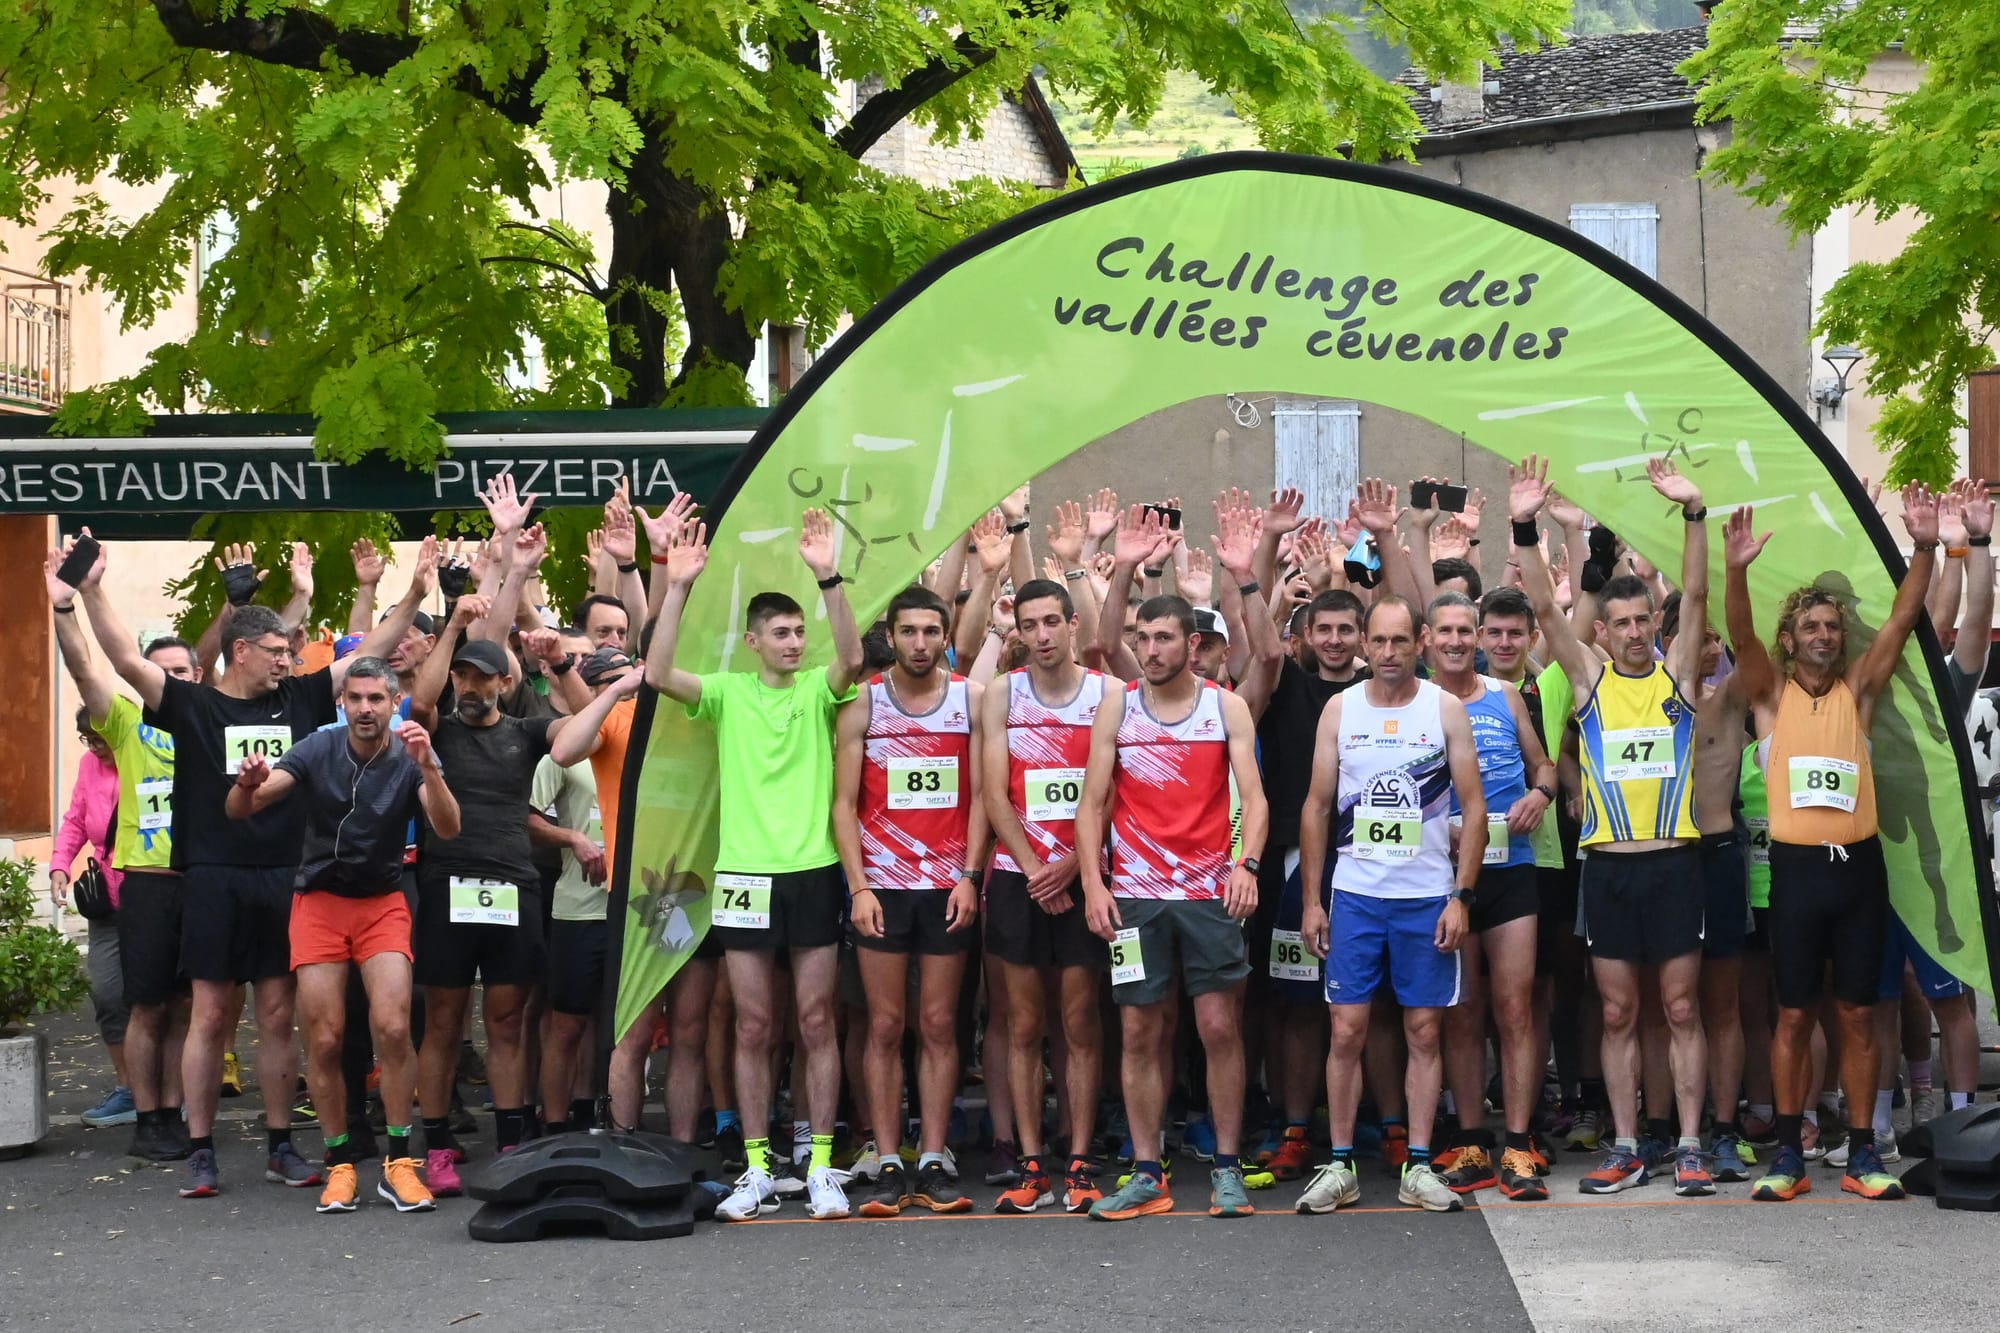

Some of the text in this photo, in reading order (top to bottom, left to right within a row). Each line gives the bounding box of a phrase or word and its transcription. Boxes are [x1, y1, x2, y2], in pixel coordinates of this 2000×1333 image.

[1097, 236, 1540, 321] Challenge des
[1054, 296, 1570, 362] vallées cévenoles
[434, 458, 680, 498] PIZZERIA
[237, 738, 283, 758] 103
[1621, 741, 1655, 763] 47
[907, 771, 941, 792] 83
[1807, 770, 1841, 791] 89
[1045, 782, 1079, 803] 60
[1369, 822, 1403, 844] 64
[1747, 830, 1769, 849] 4
[478, 890, 493, 907] 6
[722, 888, 751, 910] 74
[1110, 945, 1125, 967] 5
[1278, 943, 1302, 964] 96
